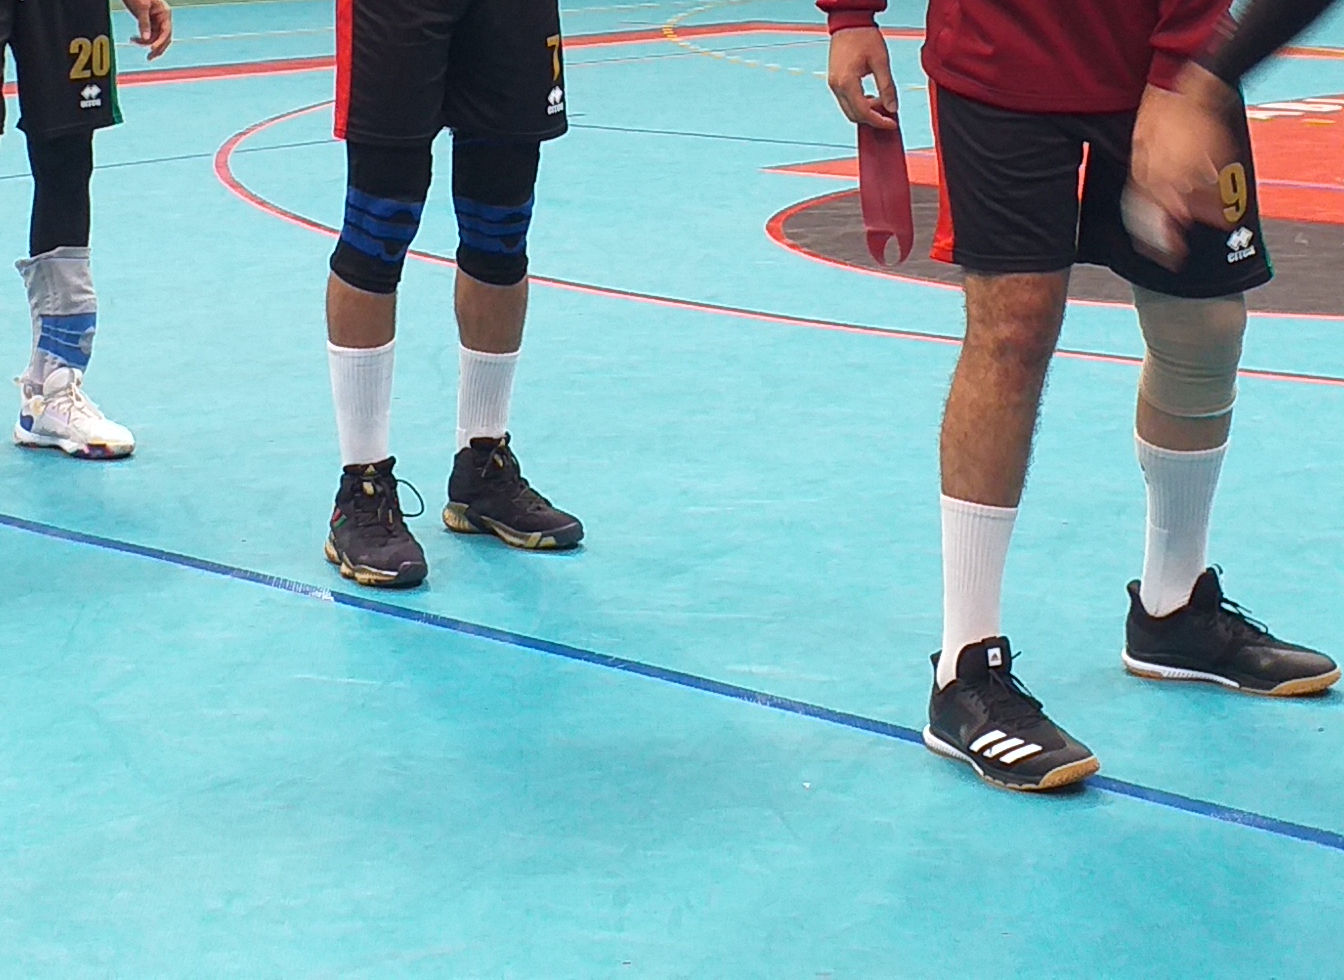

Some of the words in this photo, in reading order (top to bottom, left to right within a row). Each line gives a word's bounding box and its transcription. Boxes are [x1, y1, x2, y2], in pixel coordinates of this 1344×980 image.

[69, 34, 110, 79] 20
[546, 33, 561, 81] 7
[1218, 161, 1248, 223] 9
